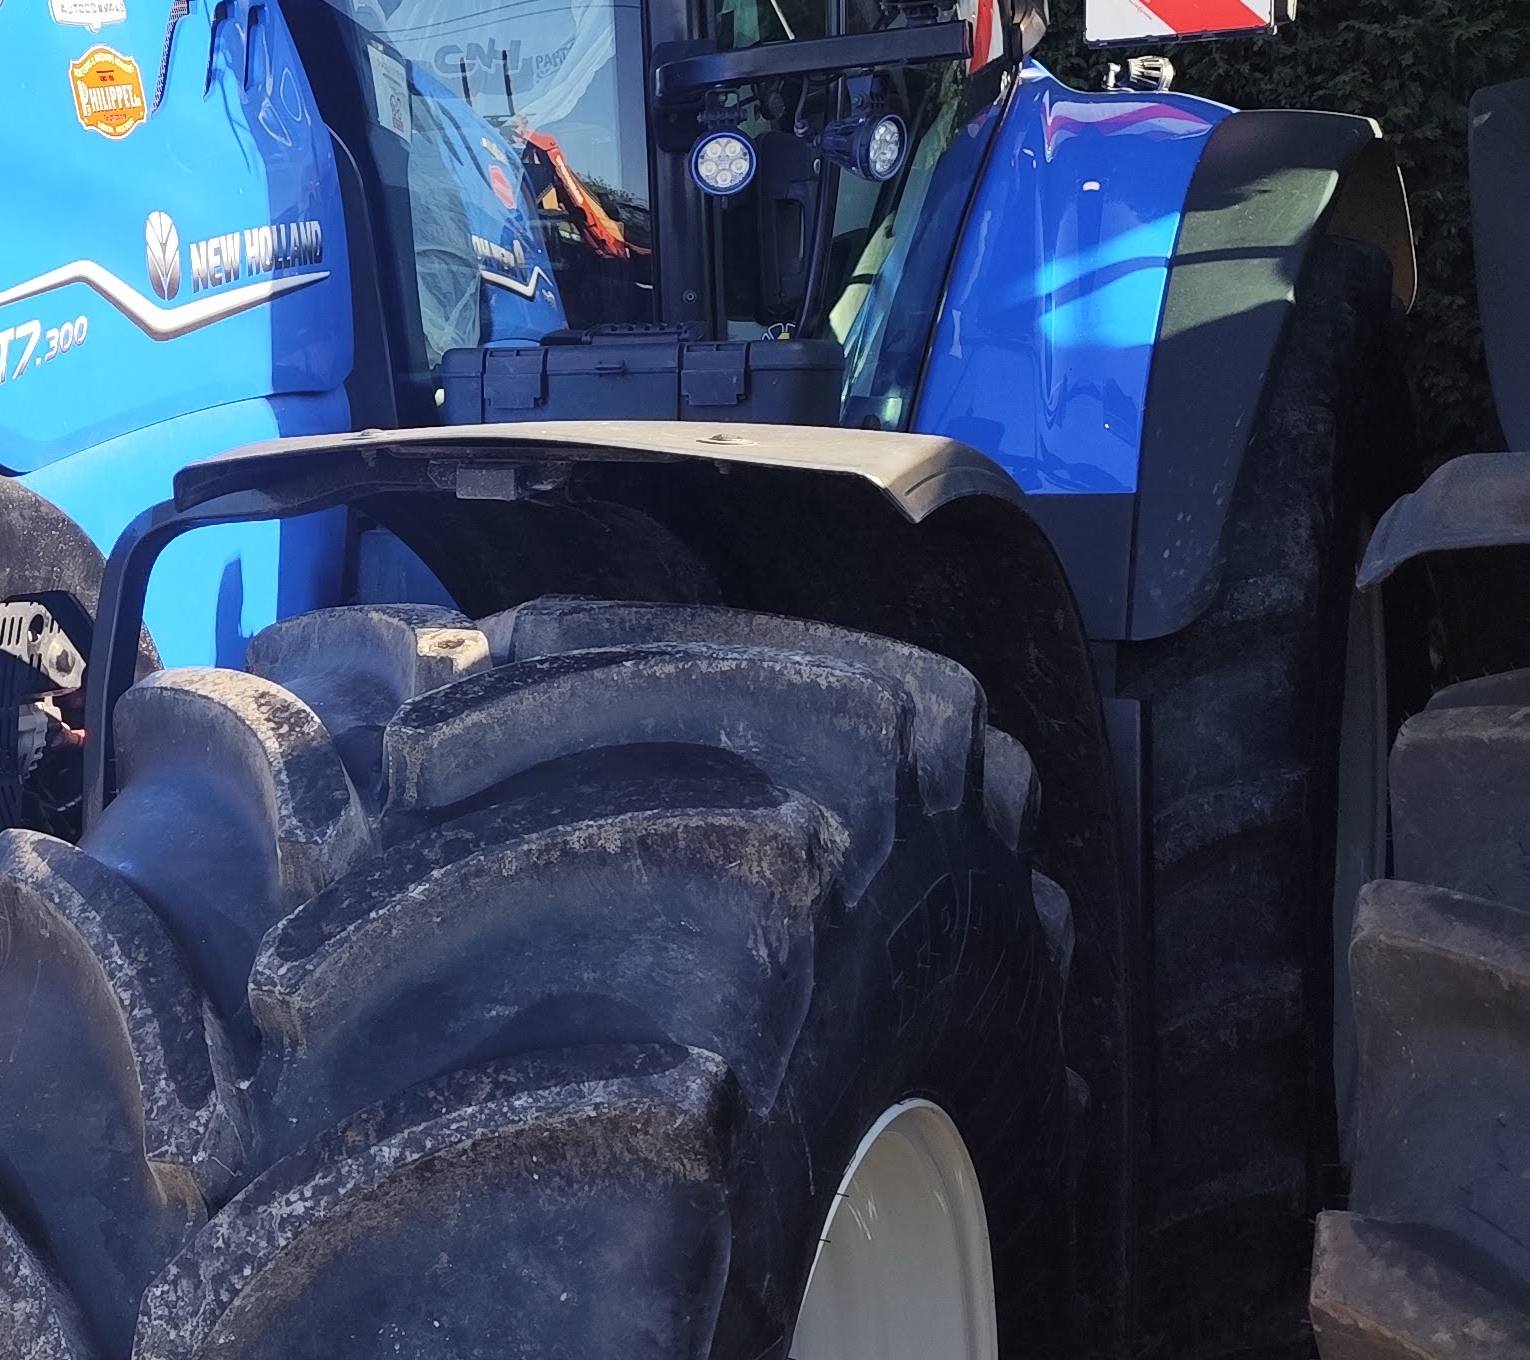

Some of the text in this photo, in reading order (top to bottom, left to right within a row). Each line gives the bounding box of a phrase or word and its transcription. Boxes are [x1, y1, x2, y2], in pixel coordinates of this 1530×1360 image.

[76, 80, 134, 117] PHILIPPET
[189, 220, 323, 294] NEW HOLLAND
